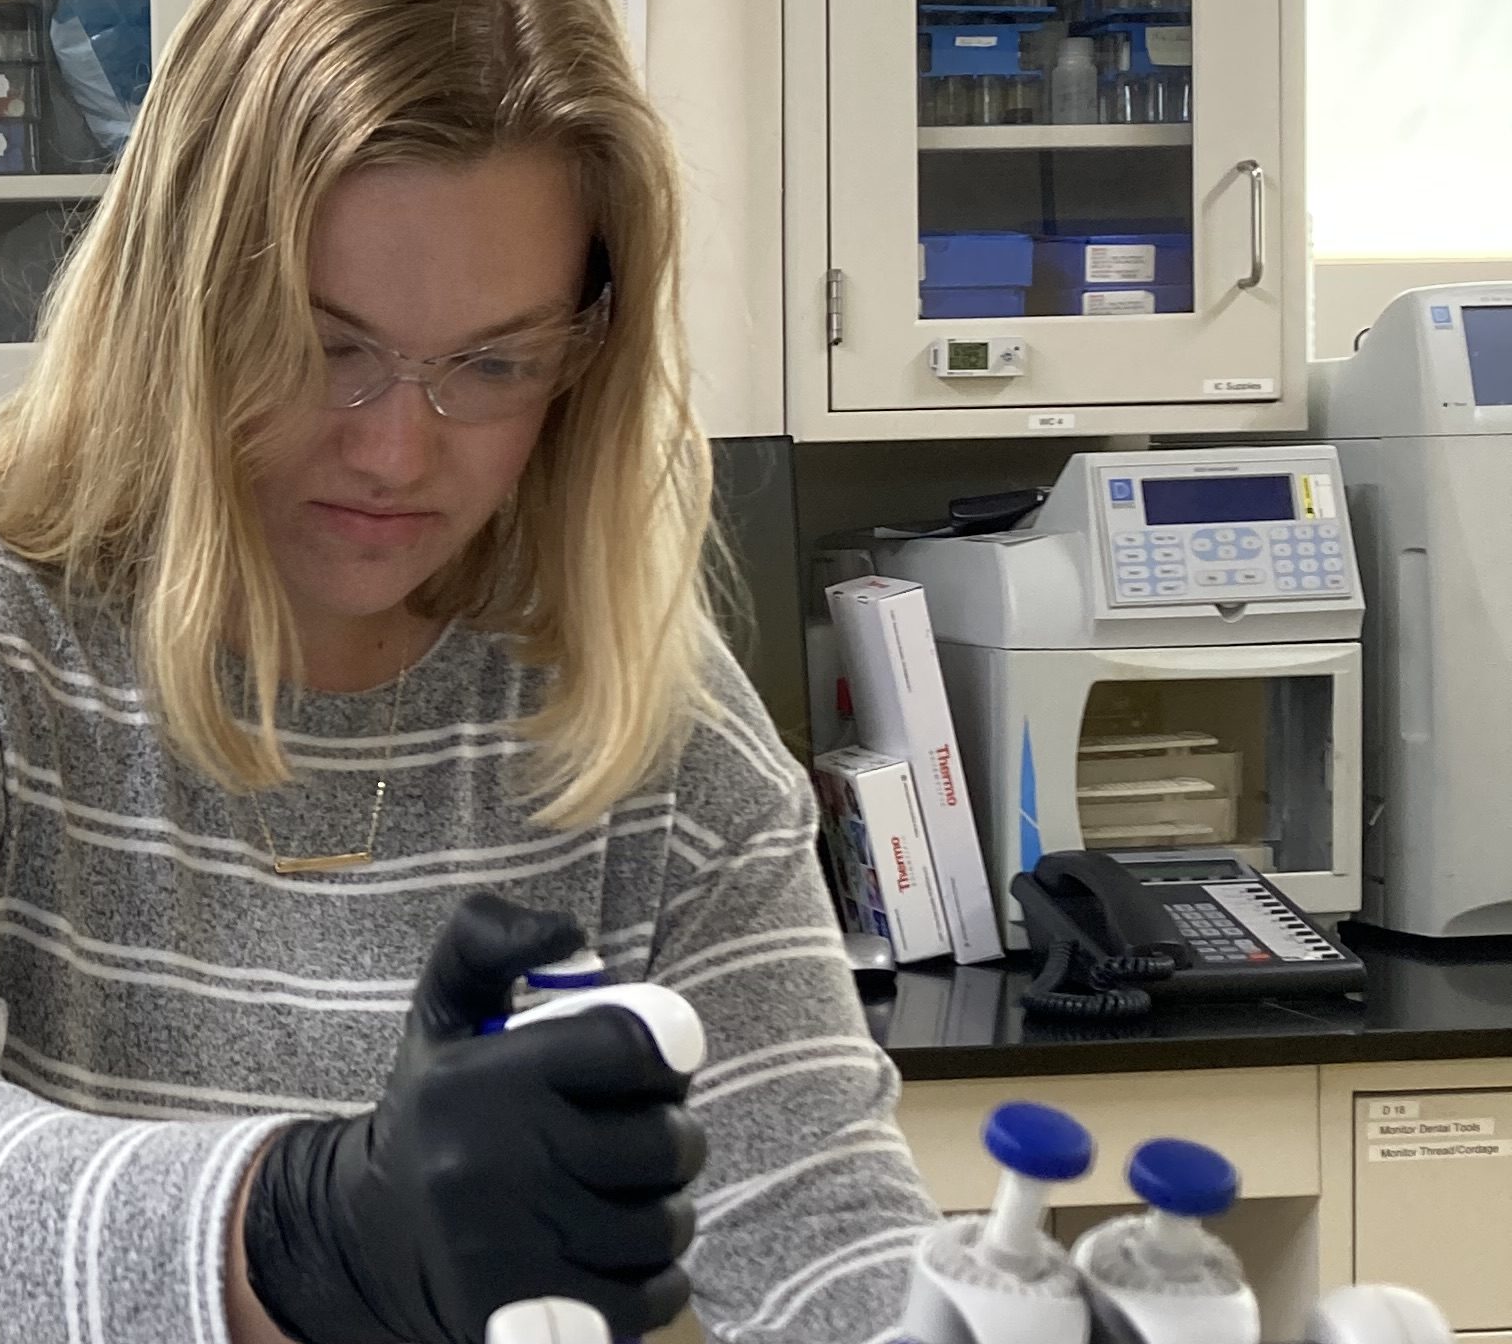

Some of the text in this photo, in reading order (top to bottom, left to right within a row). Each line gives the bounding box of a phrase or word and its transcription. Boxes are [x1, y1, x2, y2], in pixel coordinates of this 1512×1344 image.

[936, 743, 957, 806] Thermo
[891, 836, 910, 894] Thermo
[1382, 1105, 1391, 1116] D
[1453, 1122, 1480, 1132] Tools
